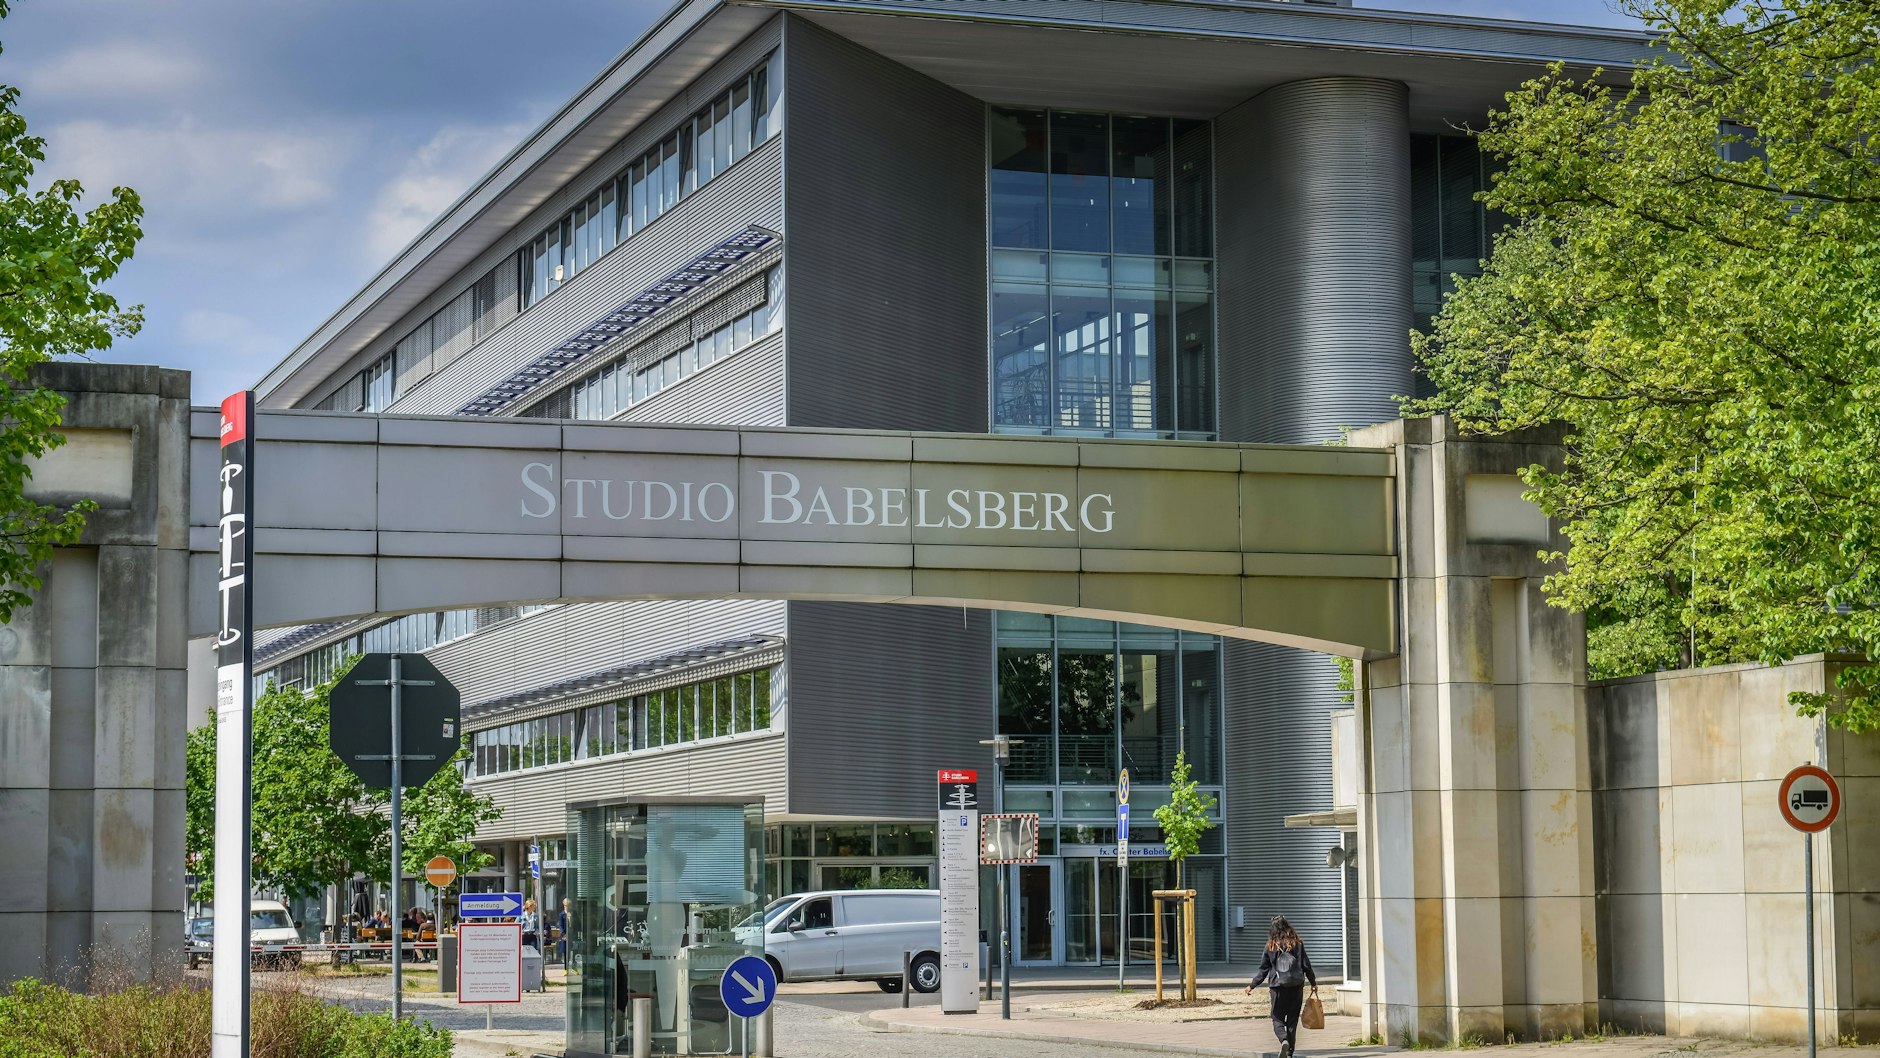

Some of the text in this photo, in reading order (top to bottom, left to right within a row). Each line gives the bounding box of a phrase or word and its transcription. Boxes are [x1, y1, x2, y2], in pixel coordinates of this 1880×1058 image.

[521, 462, 1116, 532] STUDIO BABELSBERG
[1113, 848, 1140, 856] Cter
[467, 902, 500, 910] Anmeldung
[672, 925, 721, 935] welome!
